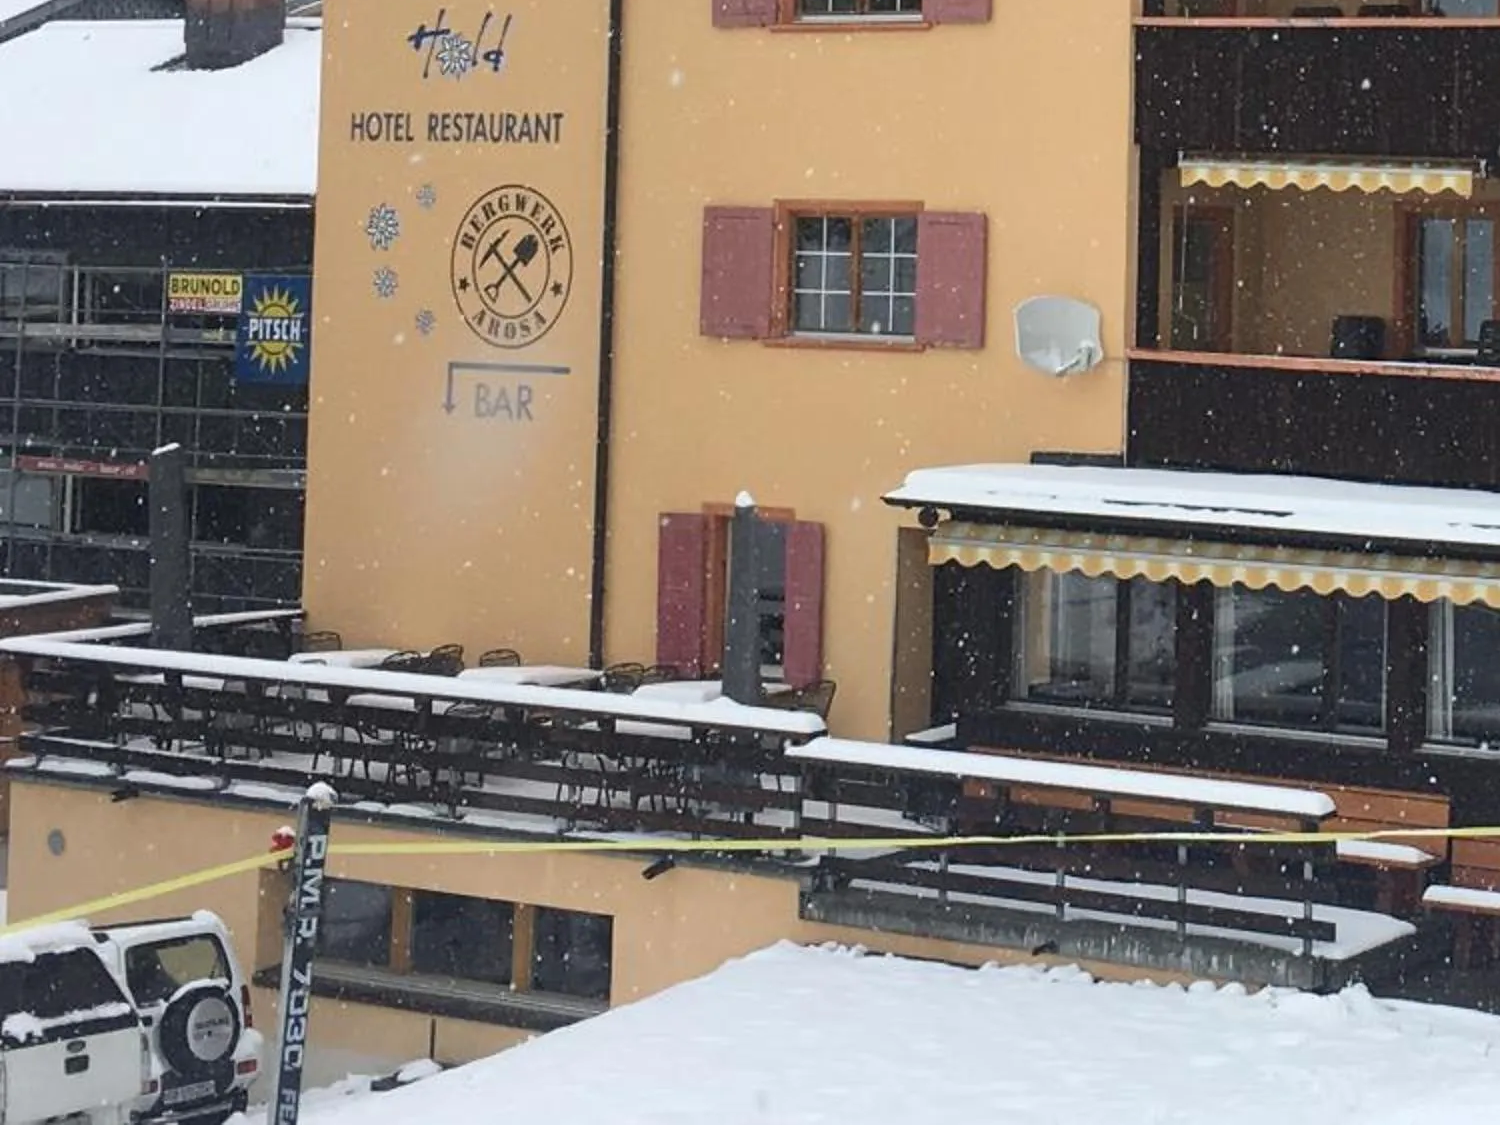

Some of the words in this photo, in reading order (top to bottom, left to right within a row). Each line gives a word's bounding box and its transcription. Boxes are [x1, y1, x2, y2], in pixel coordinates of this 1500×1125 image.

[351, 112, 415, 142] HOTEL
[428, 112, 565, 143] RESTAURANT
[460, 193, 565, 255] BERGWERK
[171, 278, 241, 296] BRUNOLD
[249, 318, 301, 341] PITSCH
[472, 309, 547, 341] AROSA
[475, 382, 534, 421] BAR
